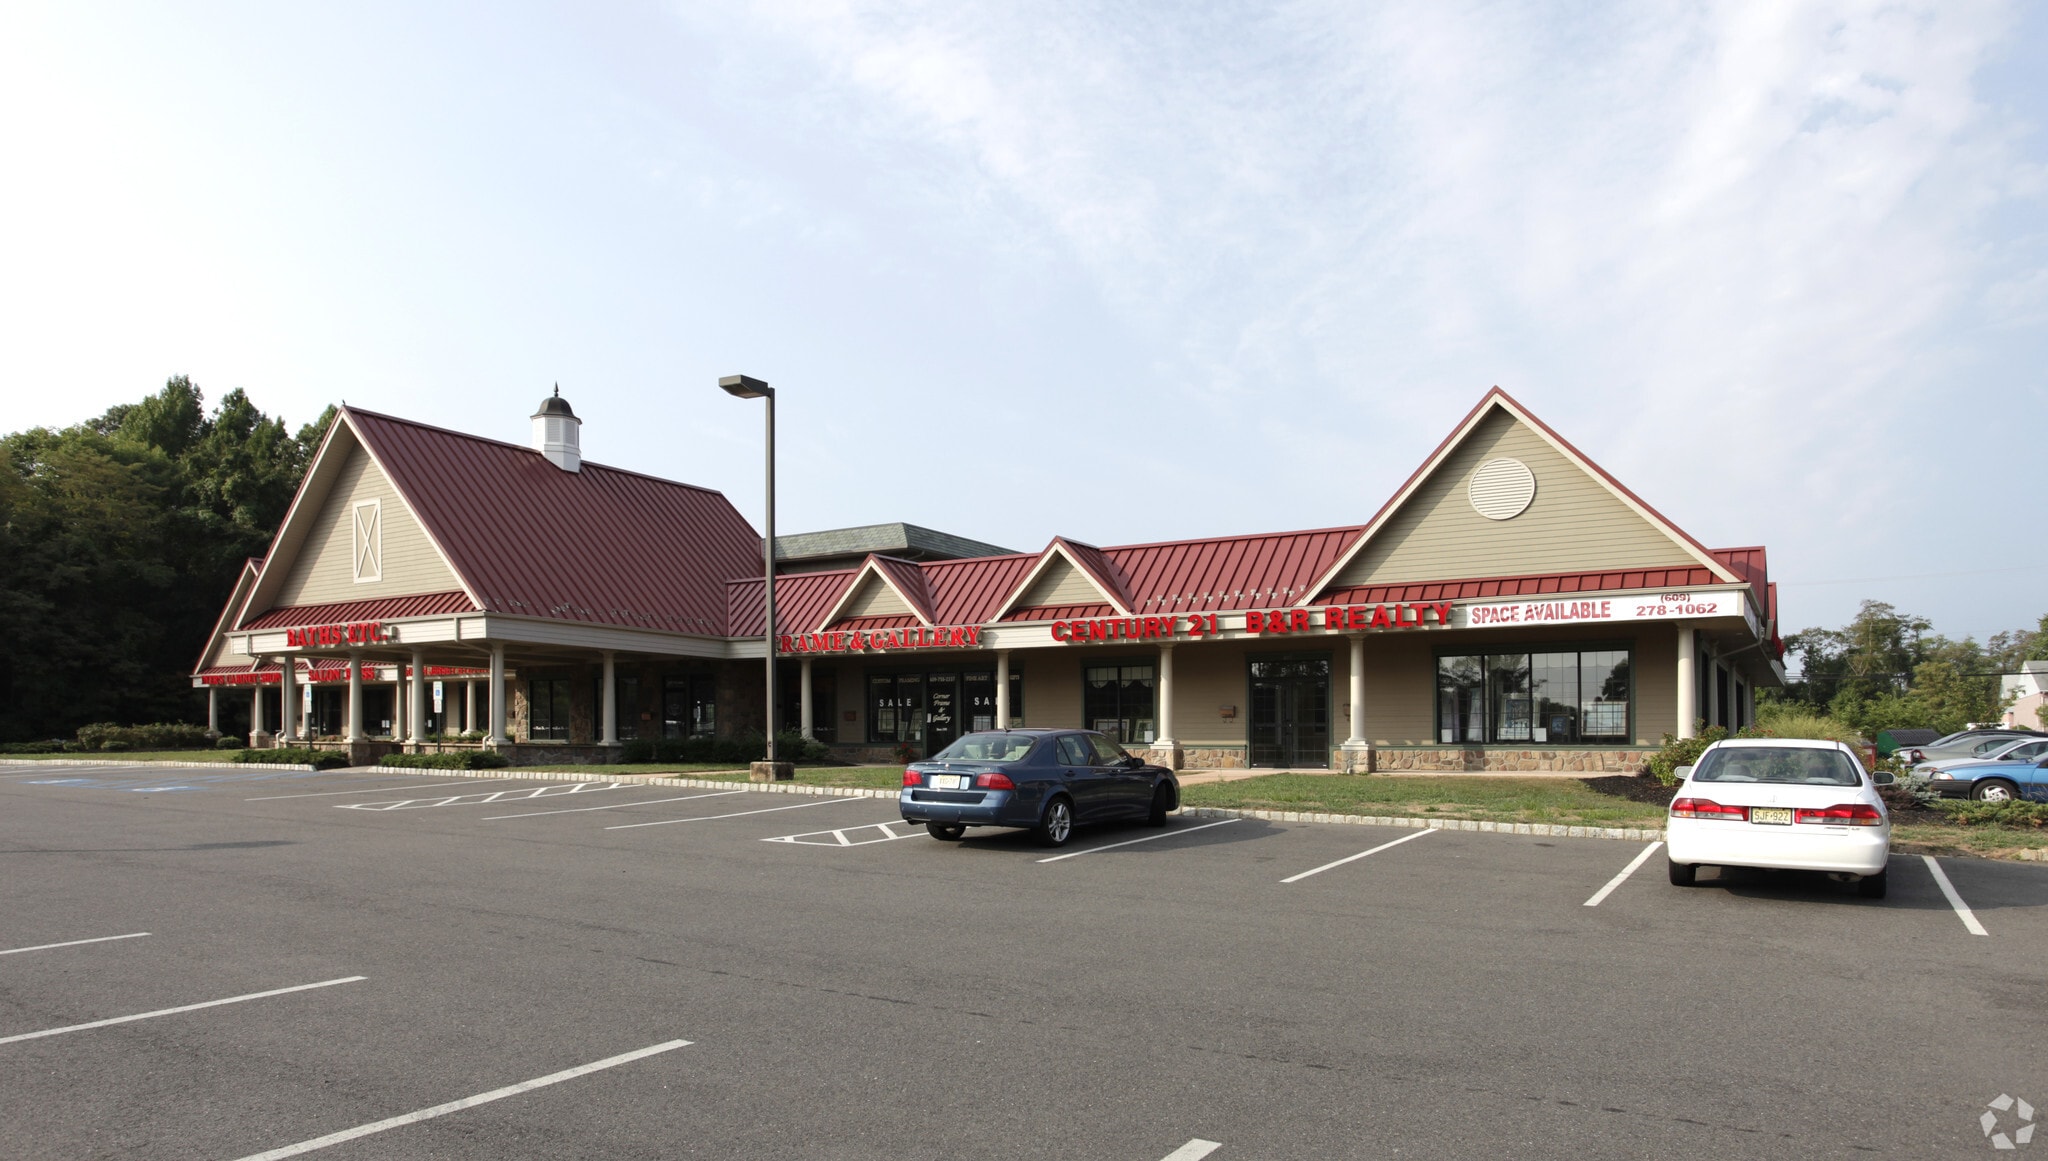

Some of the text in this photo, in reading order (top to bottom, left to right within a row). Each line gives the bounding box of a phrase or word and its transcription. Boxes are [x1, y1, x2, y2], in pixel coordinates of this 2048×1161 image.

[1660, 593, 1691, 603] (609)
[1051, 601, 1453, 642] CENTURY 21 B&R REALTY
[1471, 601, 1611, 625] SPACE AVAILABLE
[287, 621, 388, 647] BATHS ETC.
[776, 625, 981, 653] RAME & GALLERY
[308, 669, 341, 682] SALON
[879, 698, 912, 706] SALE
